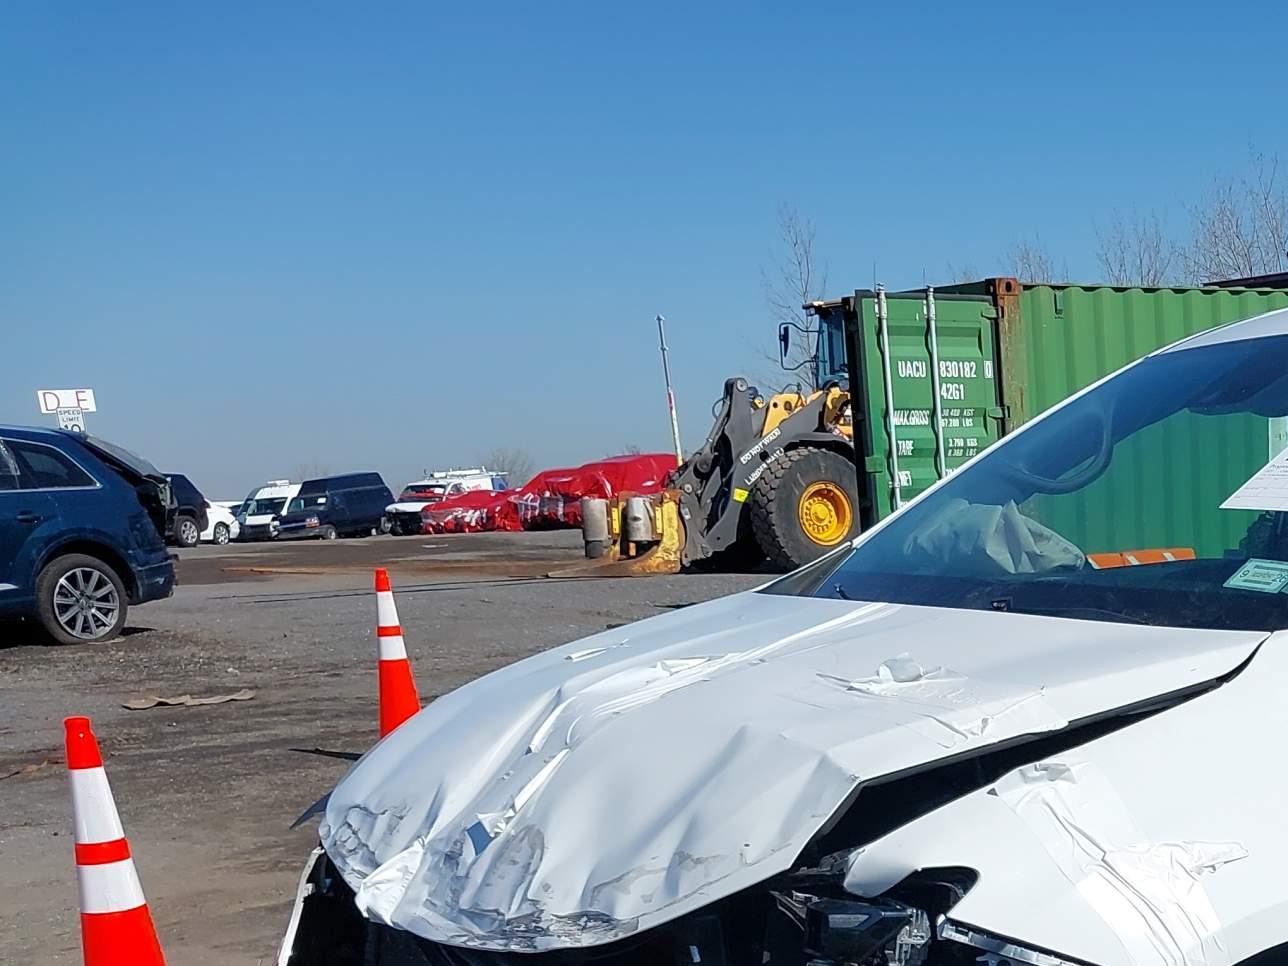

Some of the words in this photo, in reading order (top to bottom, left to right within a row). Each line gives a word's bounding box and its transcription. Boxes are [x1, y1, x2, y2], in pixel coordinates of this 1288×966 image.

[898, 361, 926, 378] UACU
[939, 360, 976, 378] 830182
[941, 383, 965, 400] 42G1
